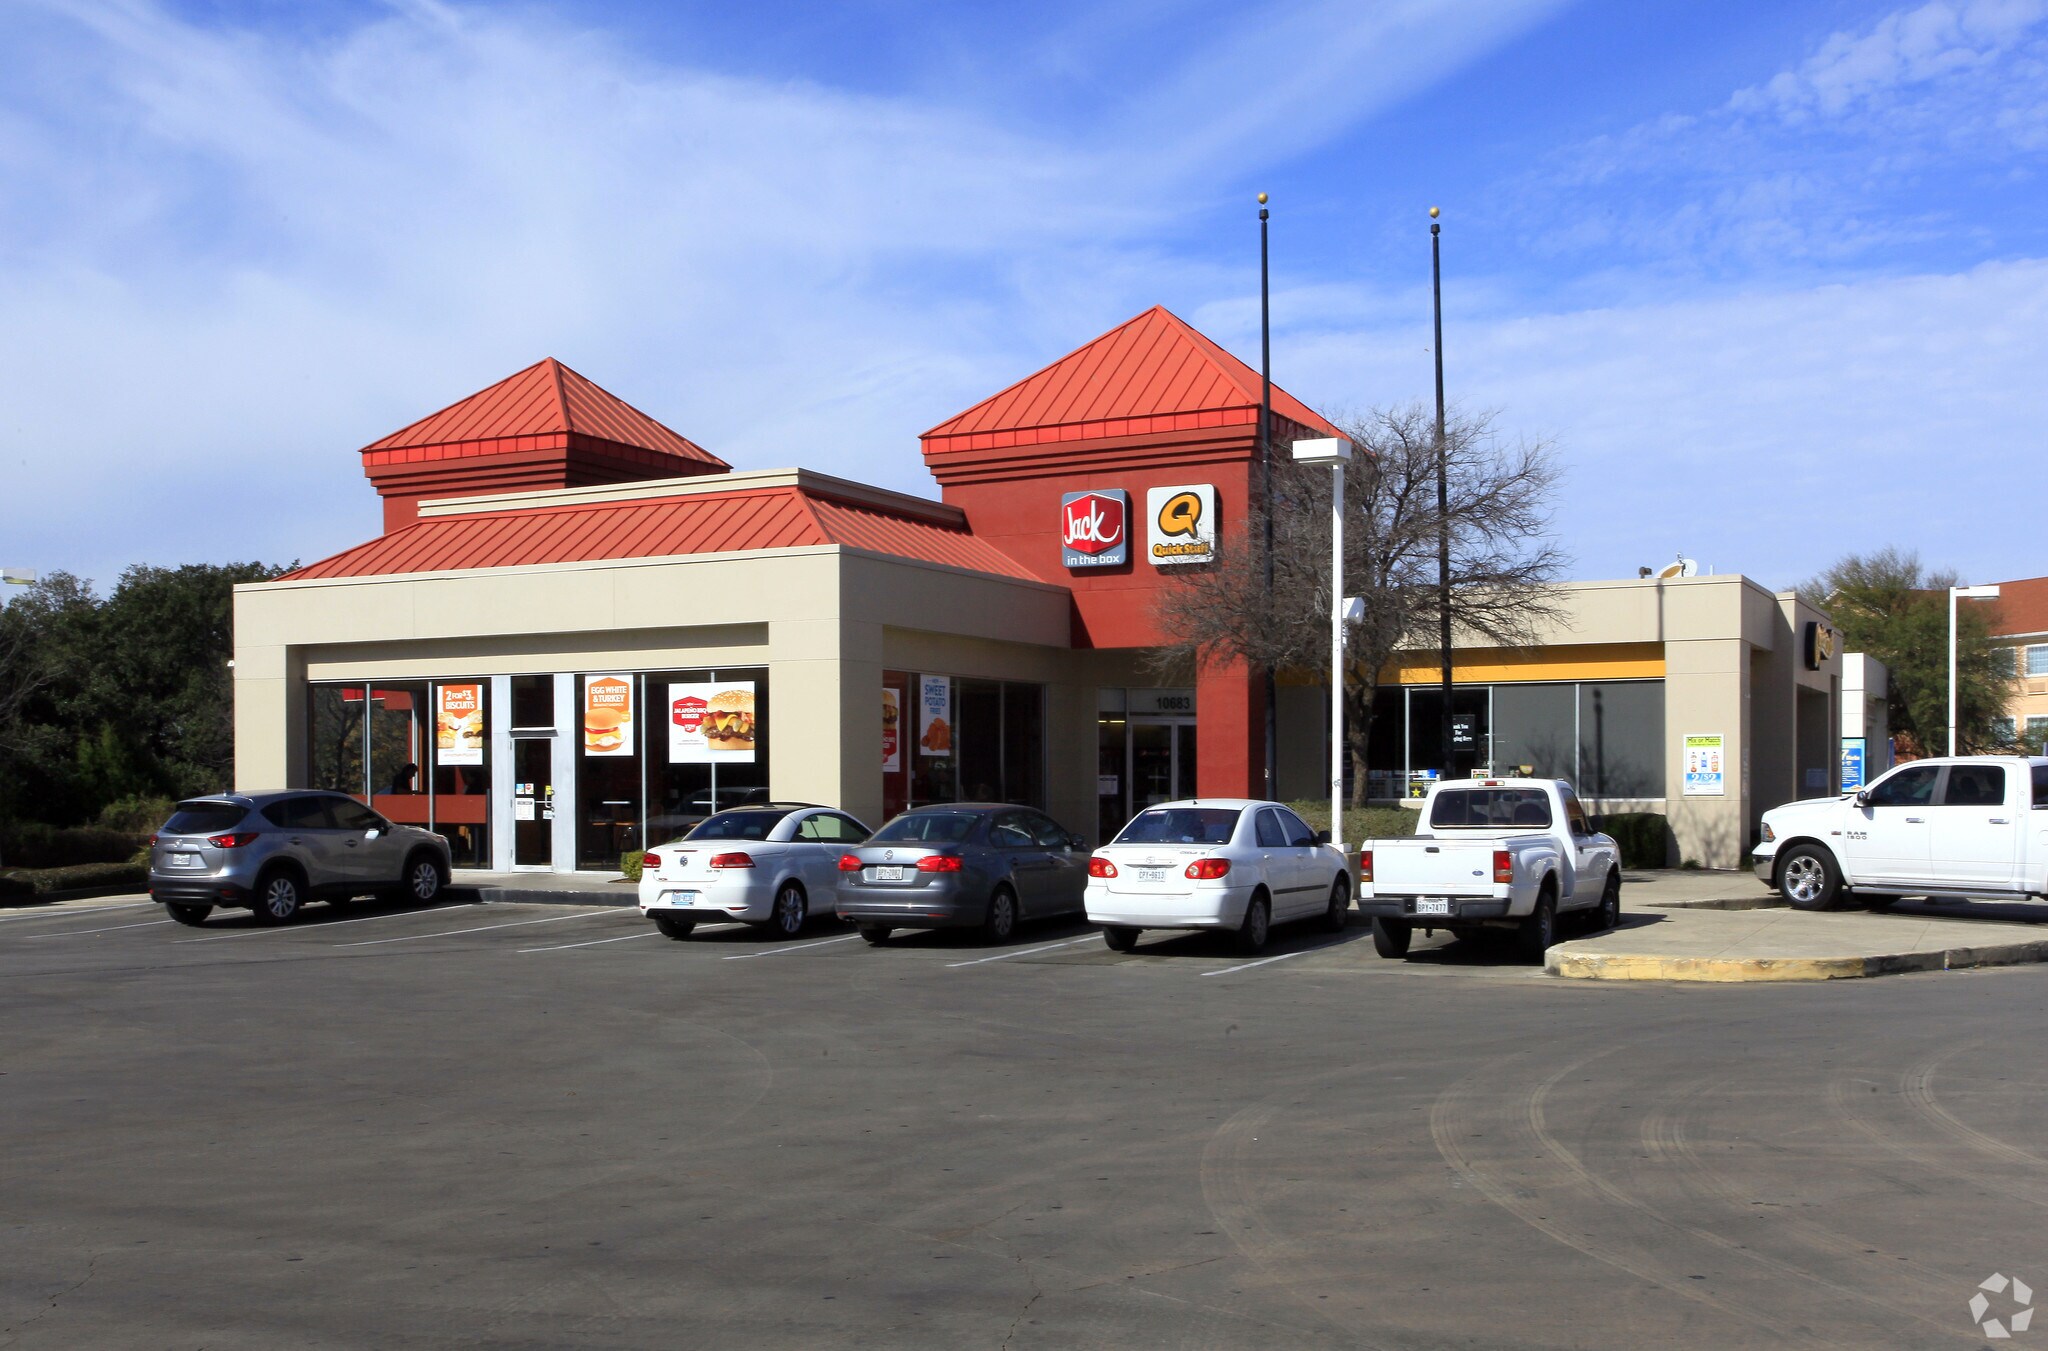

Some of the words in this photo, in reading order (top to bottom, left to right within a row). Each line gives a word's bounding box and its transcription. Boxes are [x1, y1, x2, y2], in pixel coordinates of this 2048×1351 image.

[1064, 500, 1120, 544] Jack
[1153, 543, 1182, 558] Quick
[1067, 556, 1077, 565] in
[1079, 555, 1098, 564] the
[1100, 554, 1120, 563] box
[445, 690, 452, 700] 2
[591, 686, 604, 694] EGG
[605, 686, 627, 694] WHITE
[925, 684, 946, 696] SWEET
[598, 694, 625, 702] TURKEY
[925, 696, 946, 707] POTATO
[1157, 697, 1190, 709] 10683
[446, 701, 475, 710] BISCUITS
